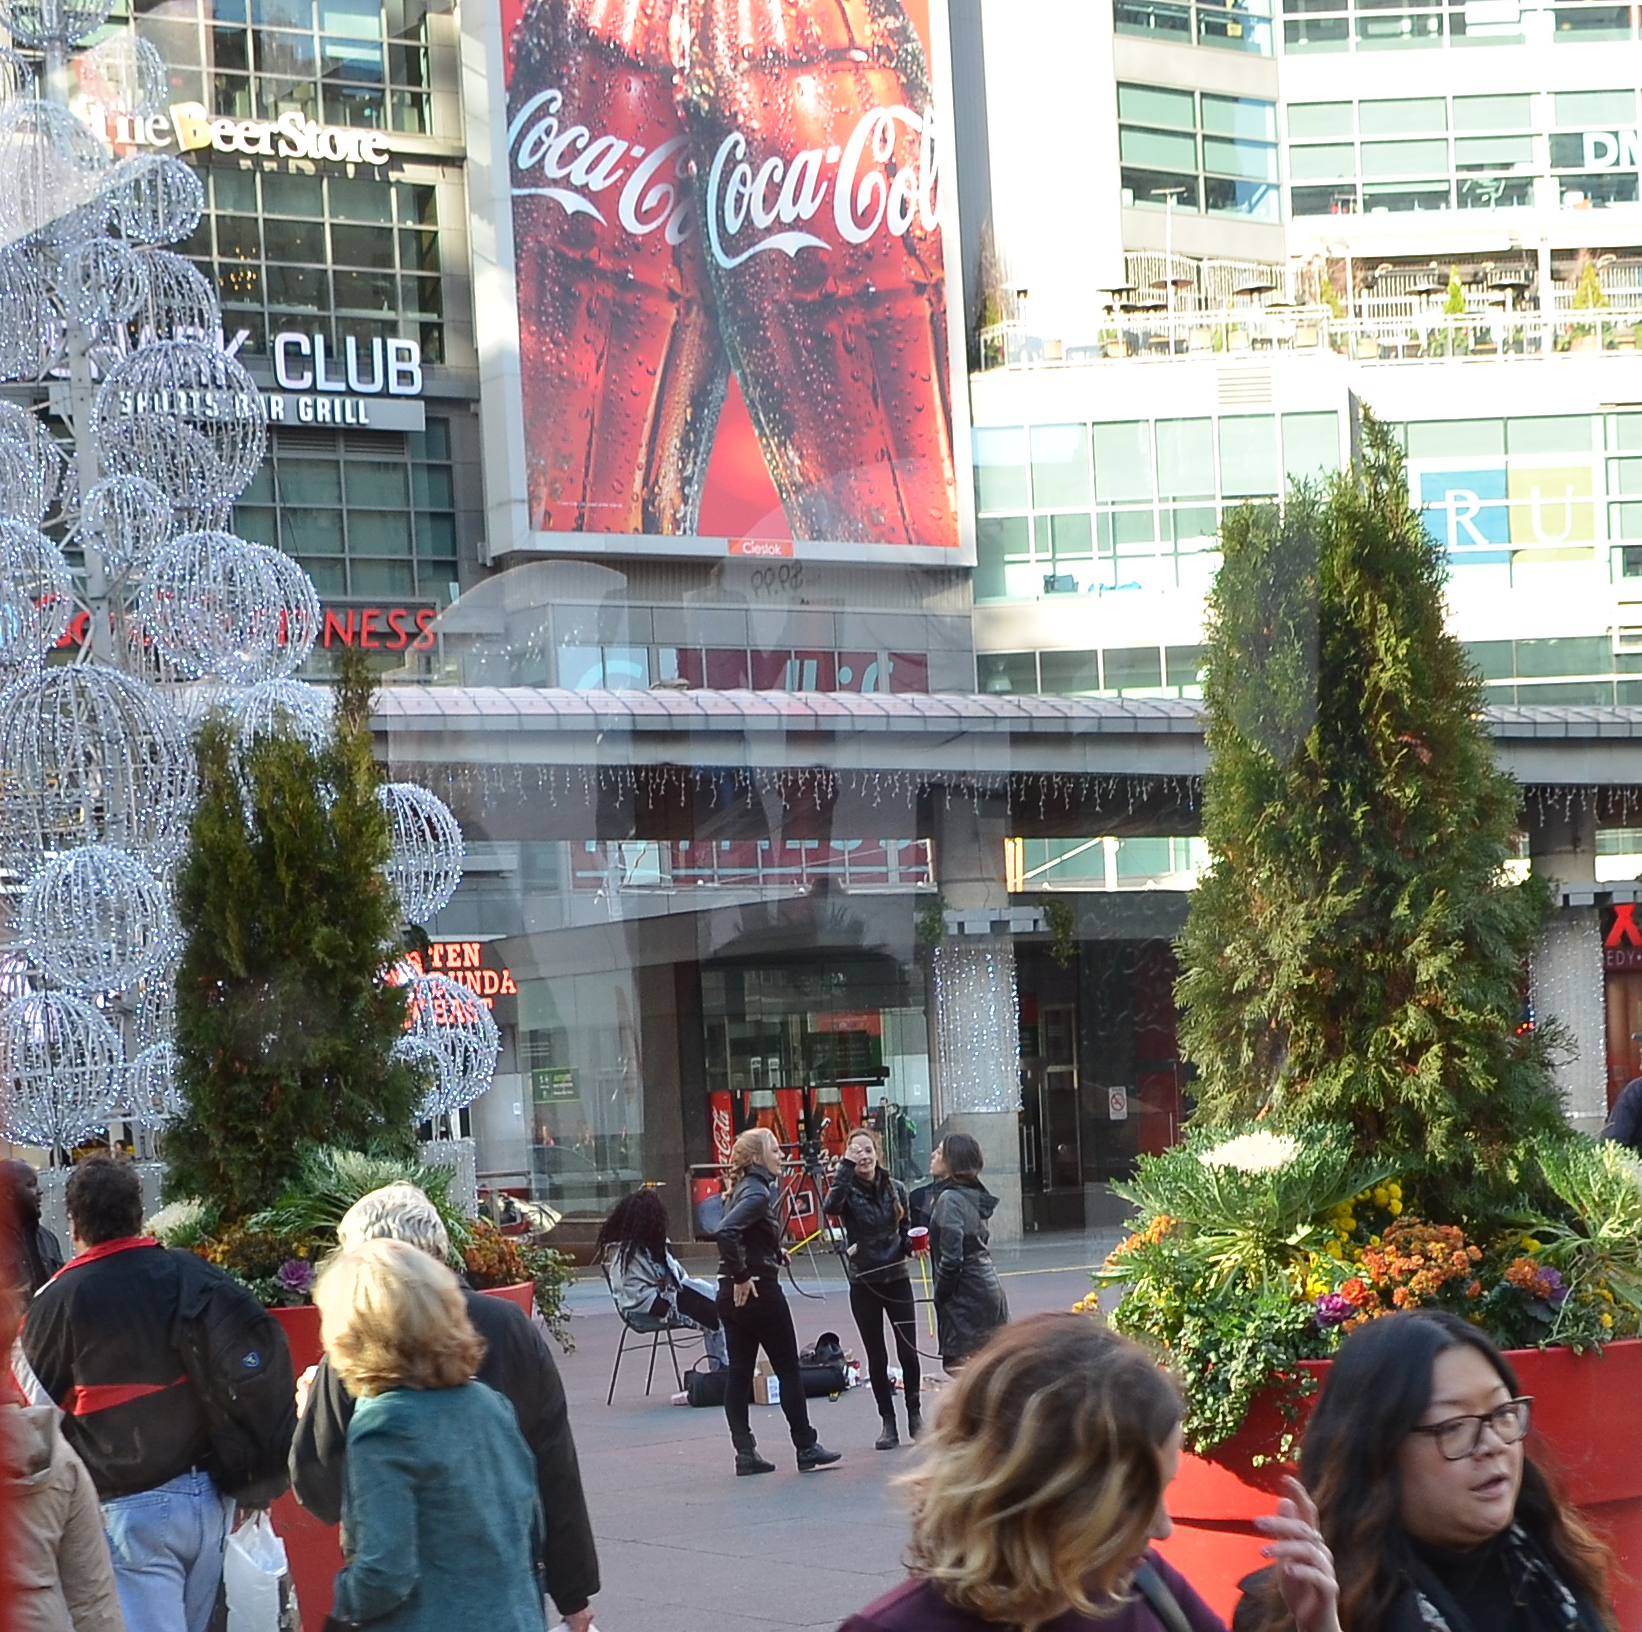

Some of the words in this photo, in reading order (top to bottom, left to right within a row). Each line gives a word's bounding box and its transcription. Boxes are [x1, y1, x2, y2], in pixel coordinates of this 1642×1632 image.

[274, 331, 424, 396] CLUB
[298, 396, 371, 425] GRILL
[428, 942, 481, 968] TEN
